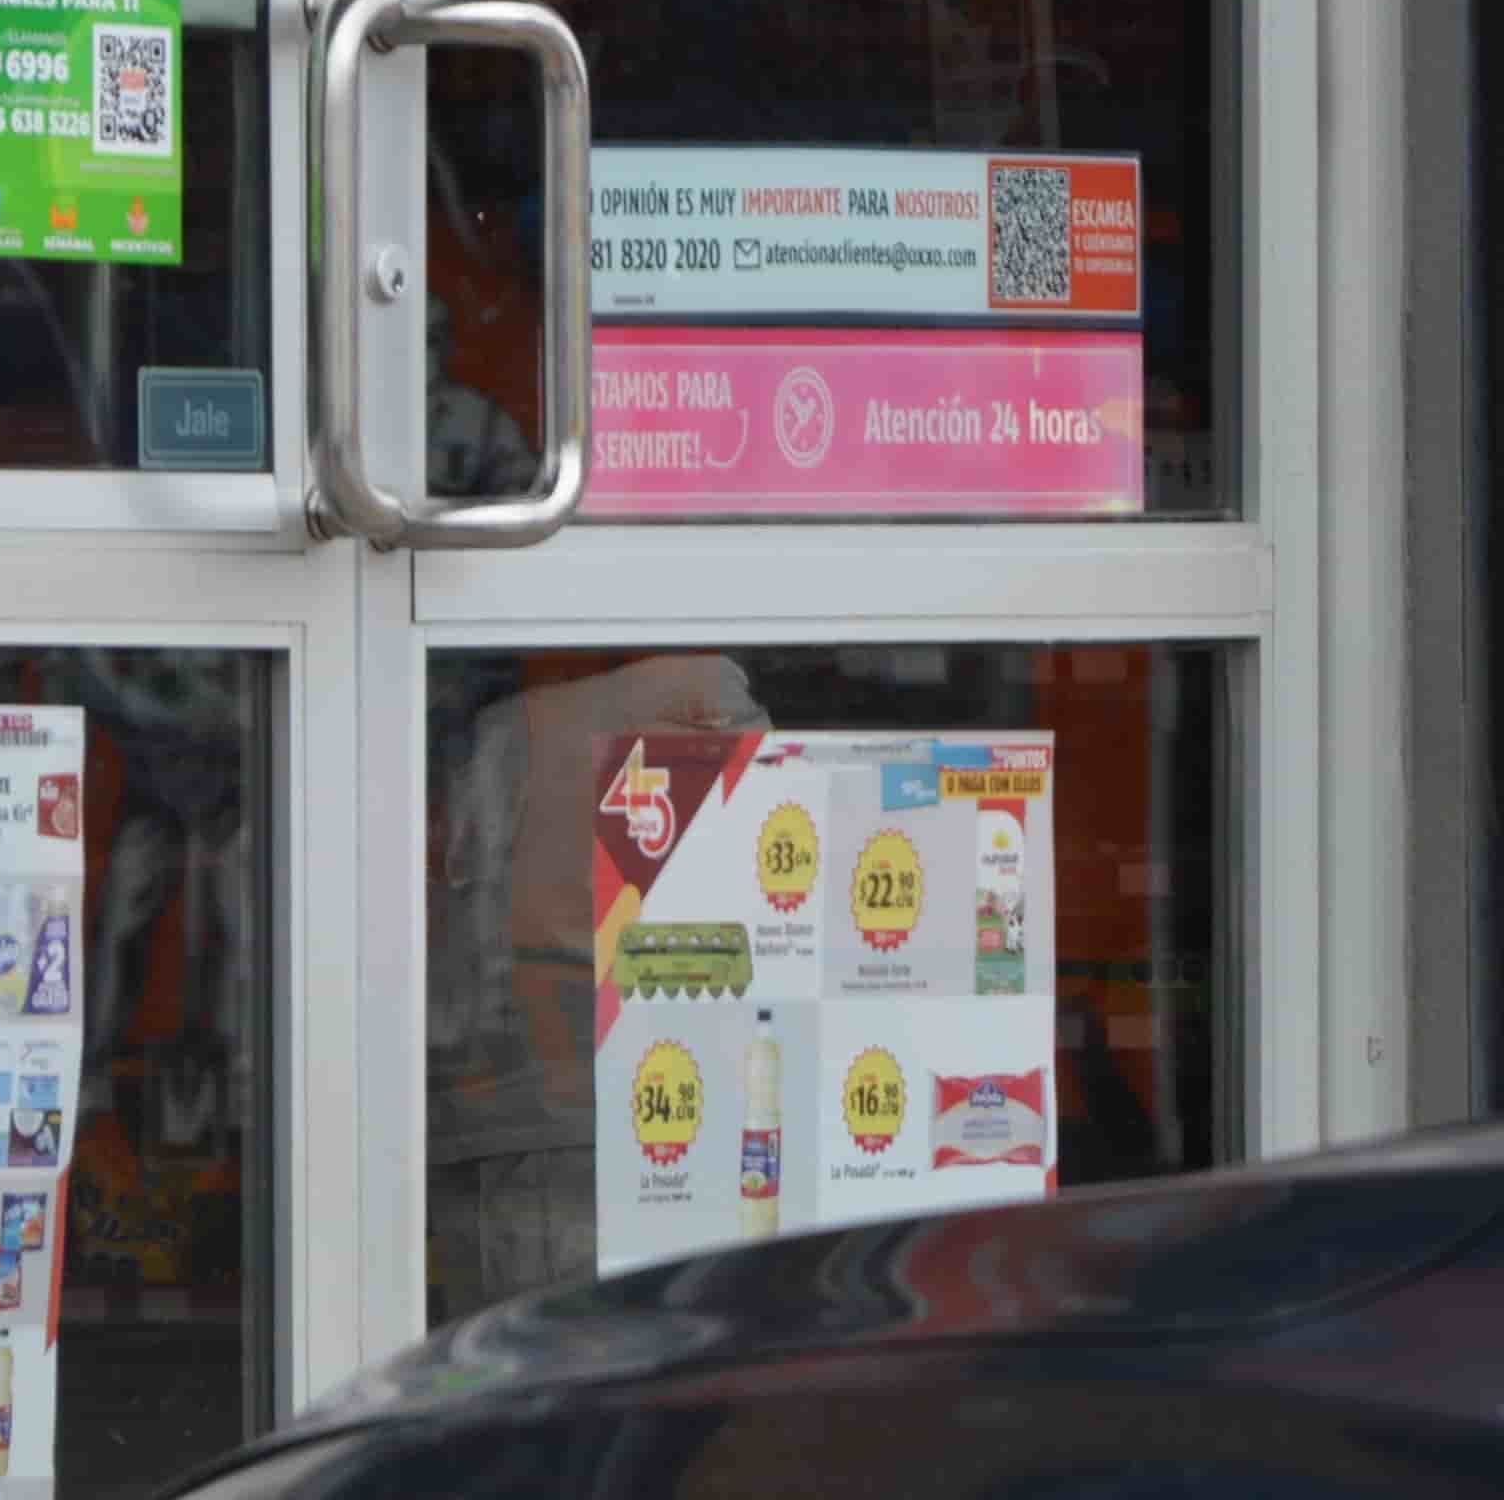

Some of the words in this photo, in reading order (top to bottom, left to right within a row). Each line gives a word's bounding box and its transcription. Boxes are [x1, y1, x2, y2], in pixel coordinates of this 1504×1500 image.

[600, 180, 670, 216] OPINIÓN
[675, 187, 695, 216] ES
[700, 187, 737, 216] MUY
[741, 187, 842, 217] IMPORTANTE
[848, 188, 890, 217] PARA
[895, 190, 980, 221] NOSOTROS!
[621, 238, 668, 270] 8320
[674, 238, 721, 270] 2020
[765, 239, 978, 273] atencionaclientes@oxxo.com
[592, 370, 673, 409] TAMOS
[676, 370, 735, 410] PARA
[863, 393, 982, 445] Atención
[990, 399, 1021, 444] 24
[1029, 398, 1104, 445] horas
[593, 431, 703, 470] SERVIRTE!
